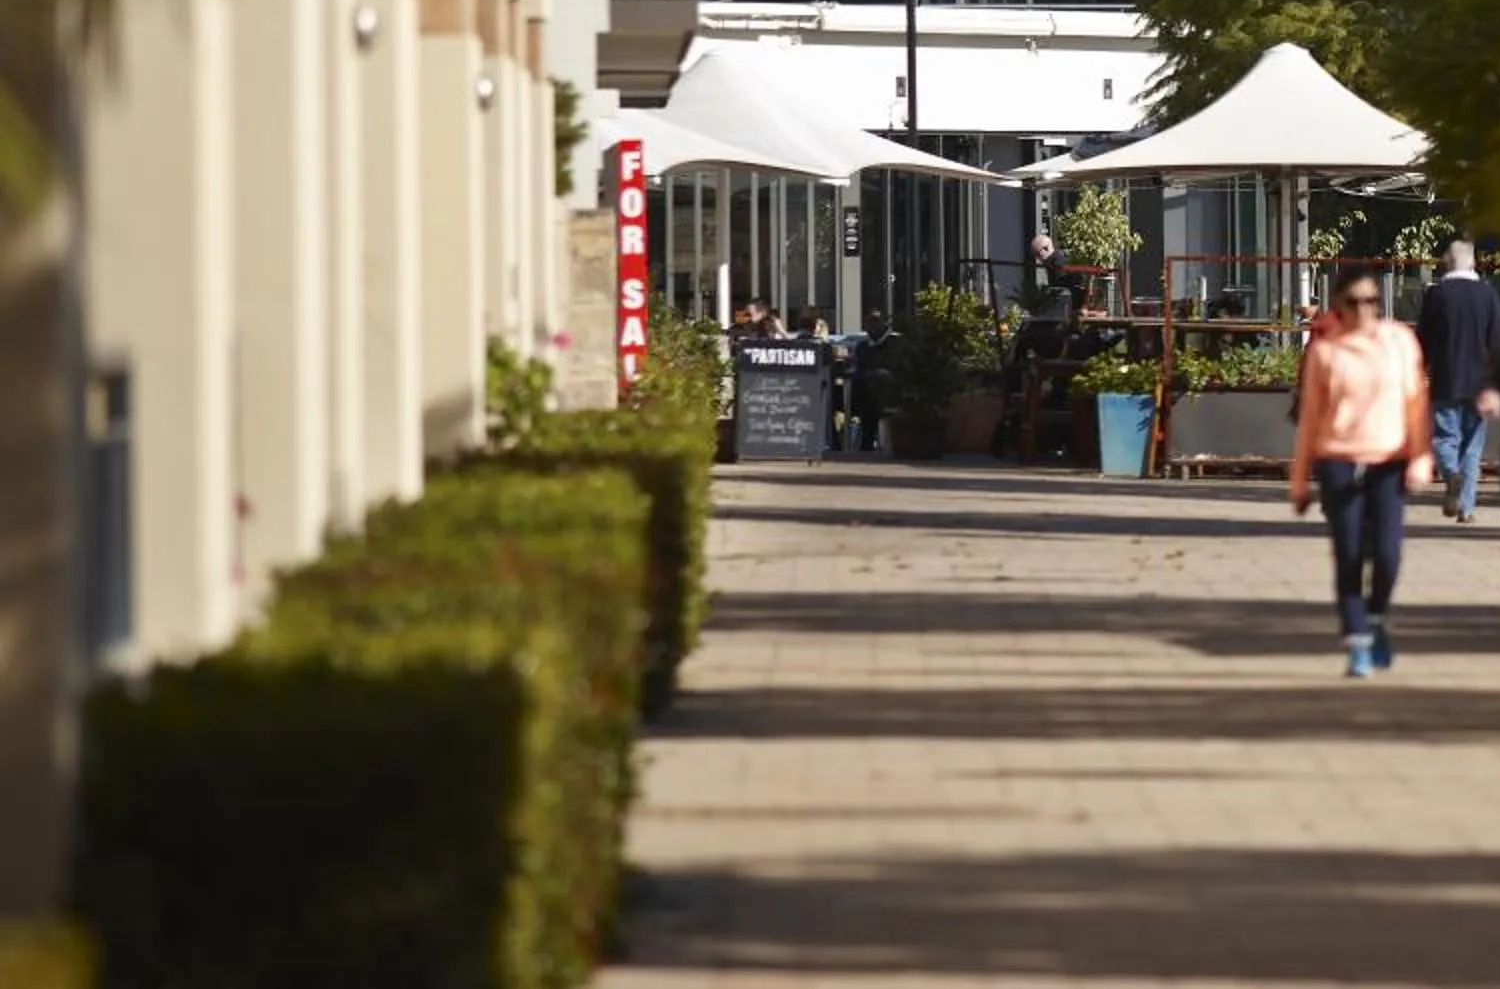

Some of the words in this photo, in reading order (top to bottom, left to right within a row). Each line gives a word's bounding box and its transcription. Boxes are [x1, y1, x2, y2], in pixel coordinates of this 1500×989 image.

[620, 150, 645, 255] FOR
[620, 278, 646, 382] SAL
[751, 348, 816, 366] PARTISAN
